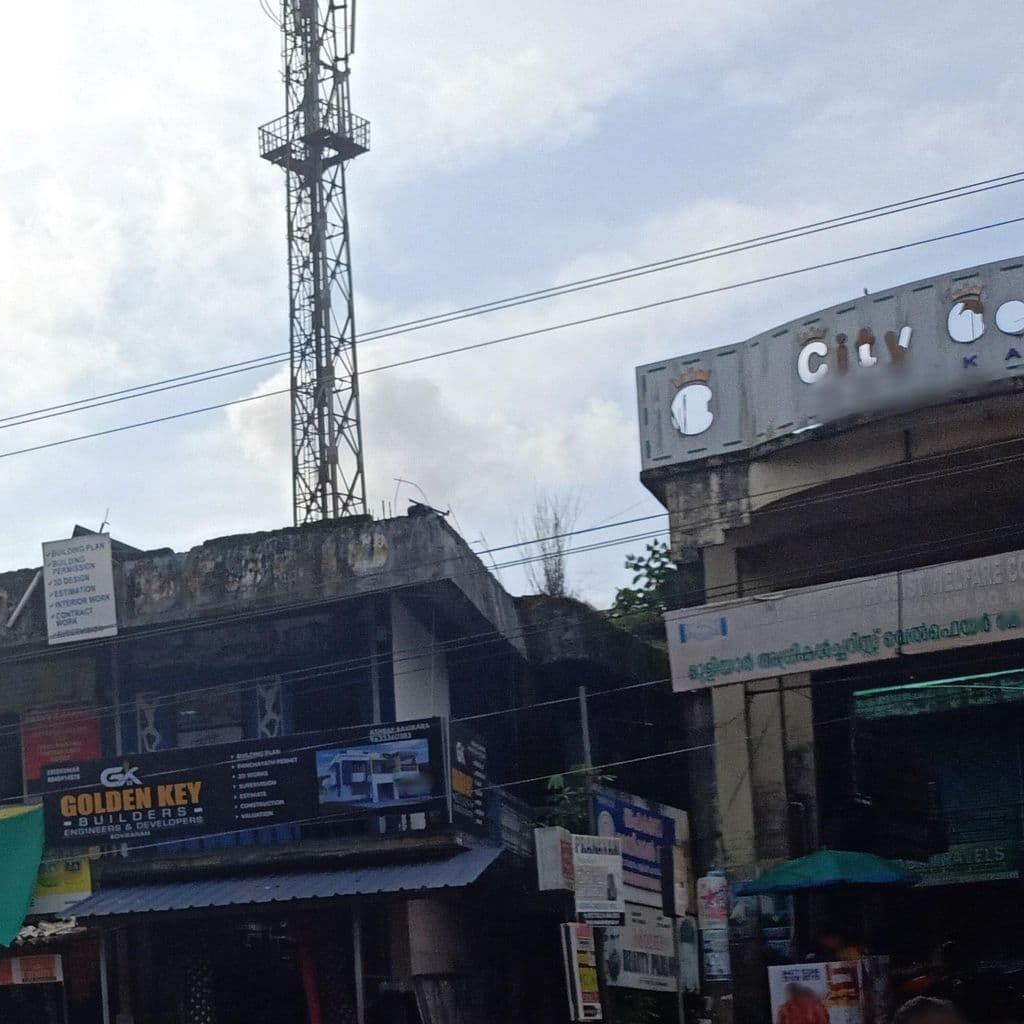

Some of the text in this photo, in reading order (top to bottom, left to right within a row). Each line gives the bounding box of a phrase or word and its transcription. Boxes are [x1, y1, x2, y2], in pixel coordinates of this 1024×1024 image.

[86, 543, 105, 552] PLAN
[63, 574, 90, 584] DESIGN
[54, 585, 96, 597] ESTIMATION
[55, 593, 110, 608] INTERIOR WORK
[56, 607, 93, 619] CONTRACT
[60, 781, 202, 817] GOLDEN KEY
[78, 806, 188, 827] BUILDERS
[64, 815, 204, 837] ENGINEERS & DEVELOPERS
